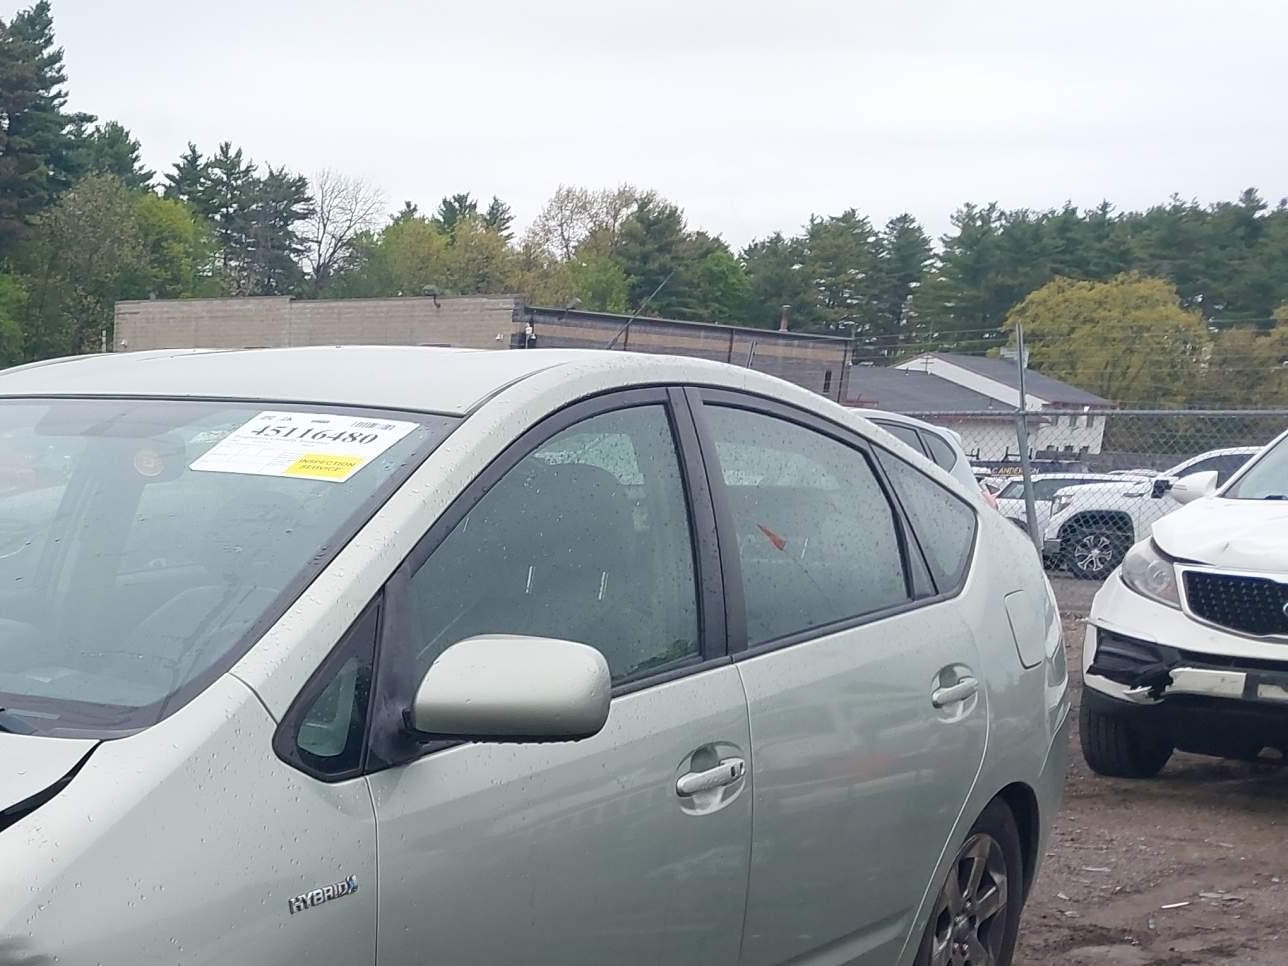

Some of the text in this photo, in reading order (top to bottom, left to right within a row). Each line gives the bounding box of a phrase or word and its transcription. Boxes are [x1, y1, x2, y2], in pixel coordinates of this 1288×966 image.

[252, 424, 378, 444] 45116480
[299, 458, 357, 468] INSPECTION
[288, 880, 349, 914] HYBRID
